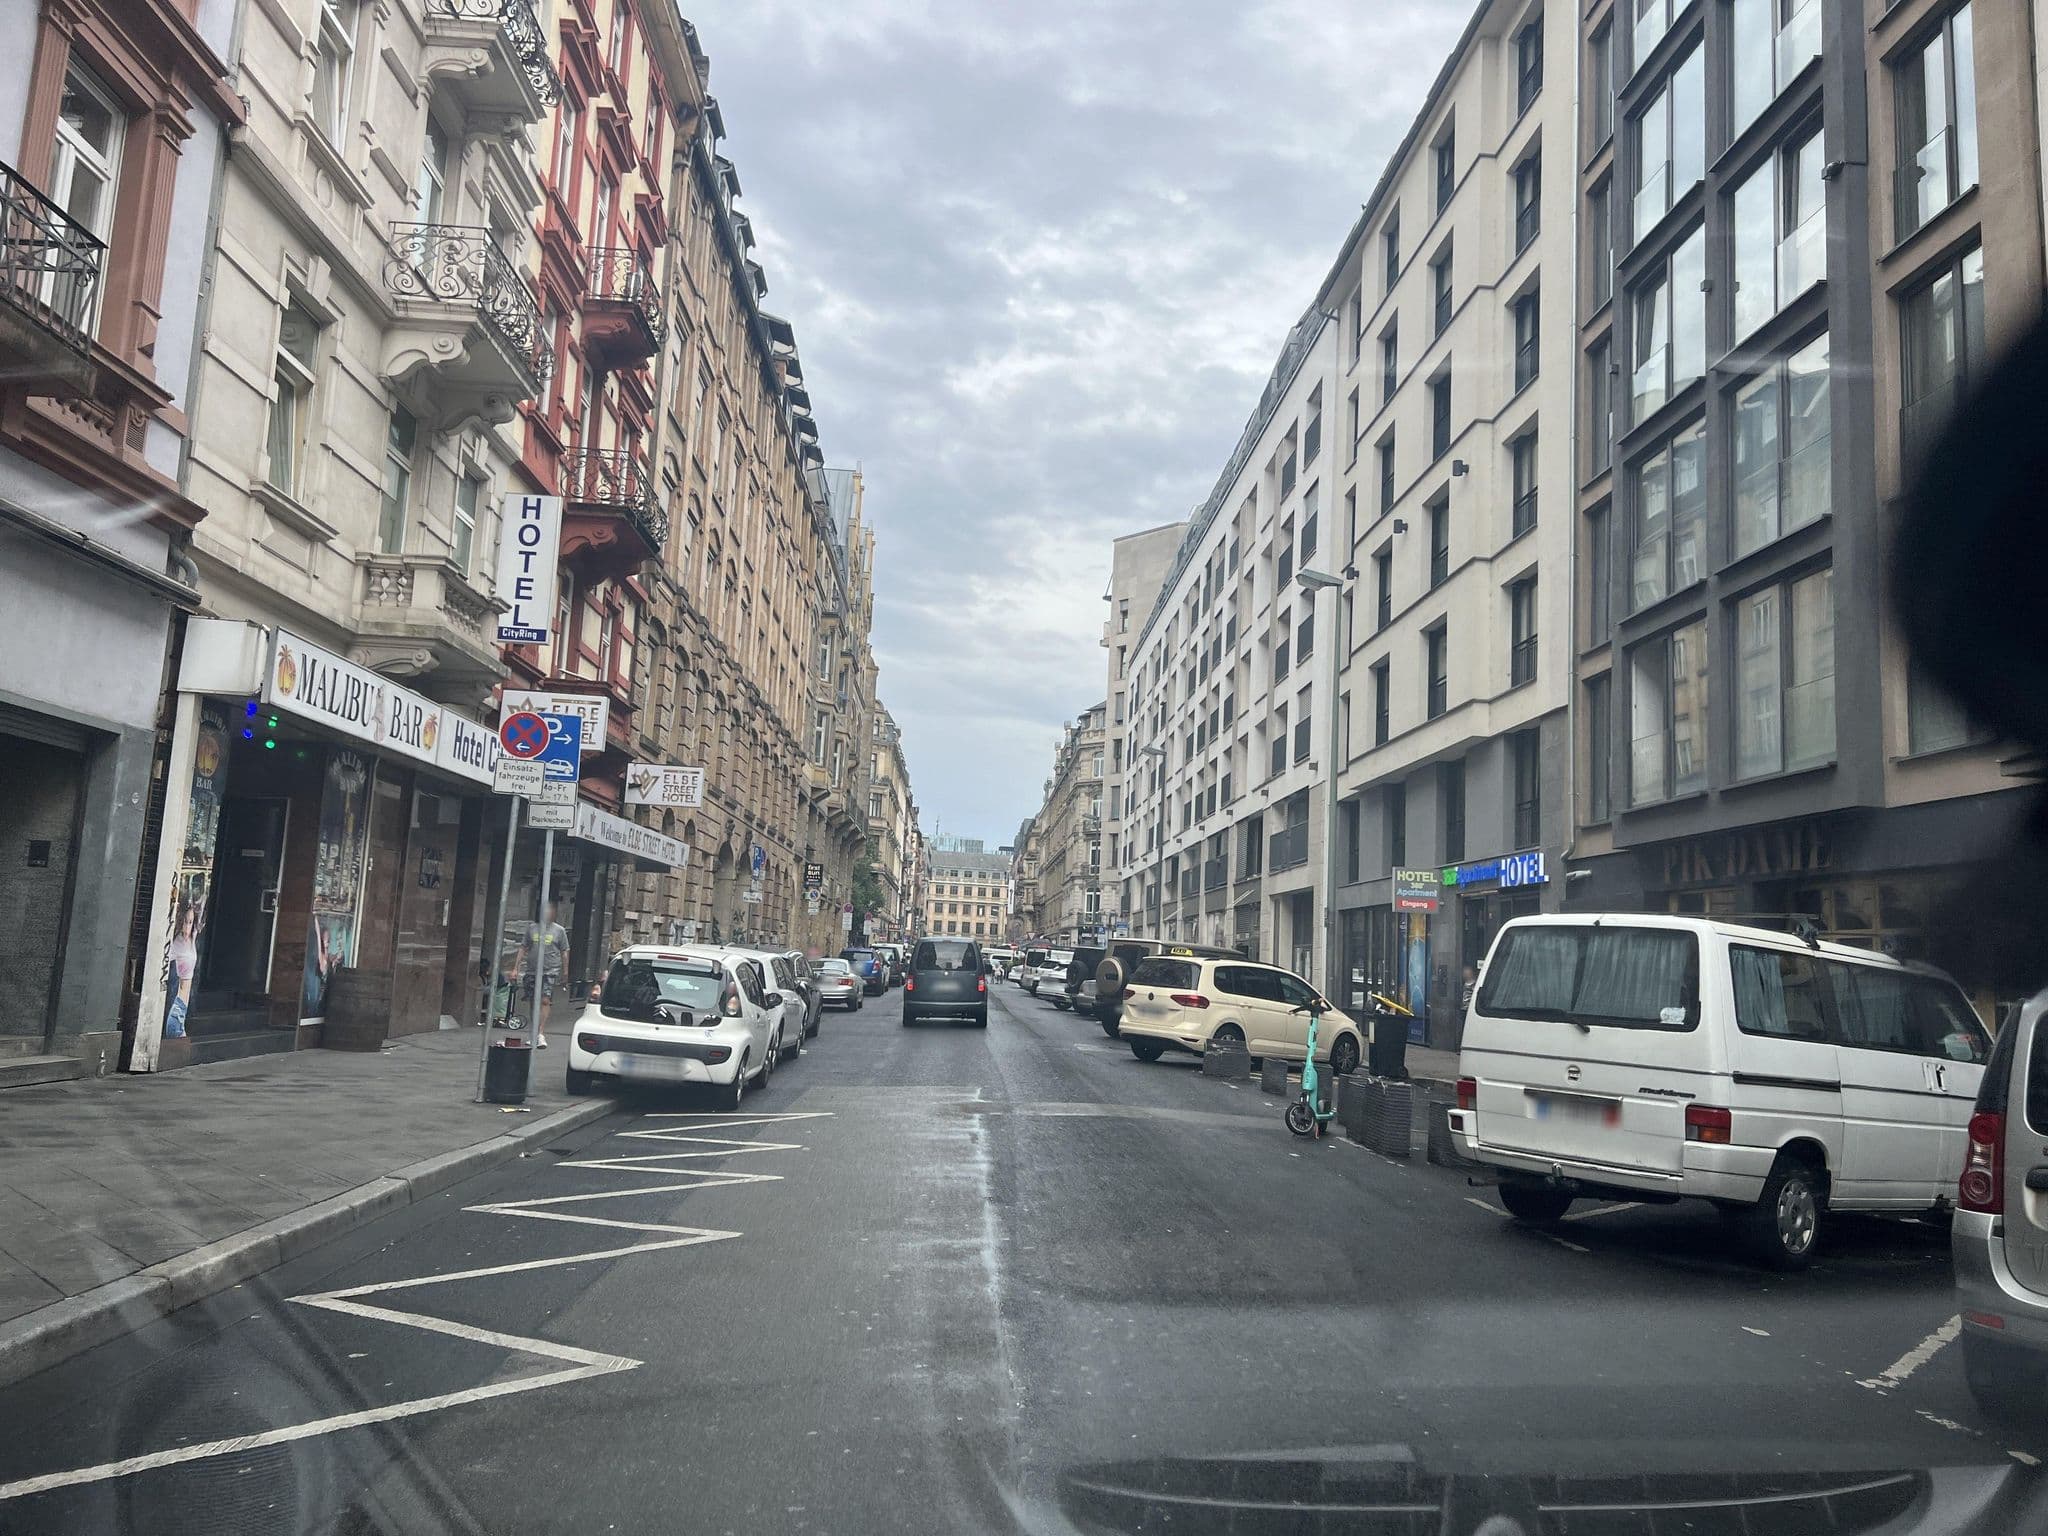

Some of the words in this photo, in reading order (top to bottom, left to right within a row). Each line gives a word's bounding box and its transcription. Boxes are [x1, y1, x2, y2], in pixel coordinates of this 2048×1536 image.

[513, 497, 541, 626] HOTEL
[502, 628, 537, 640] CityRing
[296, 653, 375, 727] MALIBU
[389, 695, 423, 748] BAR
[453, 720, 487, 769] Hotel
[503, 762, 537, 773] Einsatz-
[196, 776, 213, 790] BAR
[499, 772, 540, 783] fahrzeuge
[663, 774, 698, 785] ELBE
[511, 782, 526, 790] frei
[663, 785, 697, 794] STREET
[662, 793, 696, 803] HOTEL
[531, 816, 571, 824] Parkschein
[601, 821, 622, 844] Welcome
[627, 827, 642, 850] ELBE
[642, 833, 661, 855] STREET
[662, 840, 676, 861] HOTEL
[1500, 852, 1550, 887] HOTEL
[1396, 870, 1438, 883] HOTEL
[1396, 888, 1438, 897] Apartment
[1401, 900, 1428, 909] Eingang
